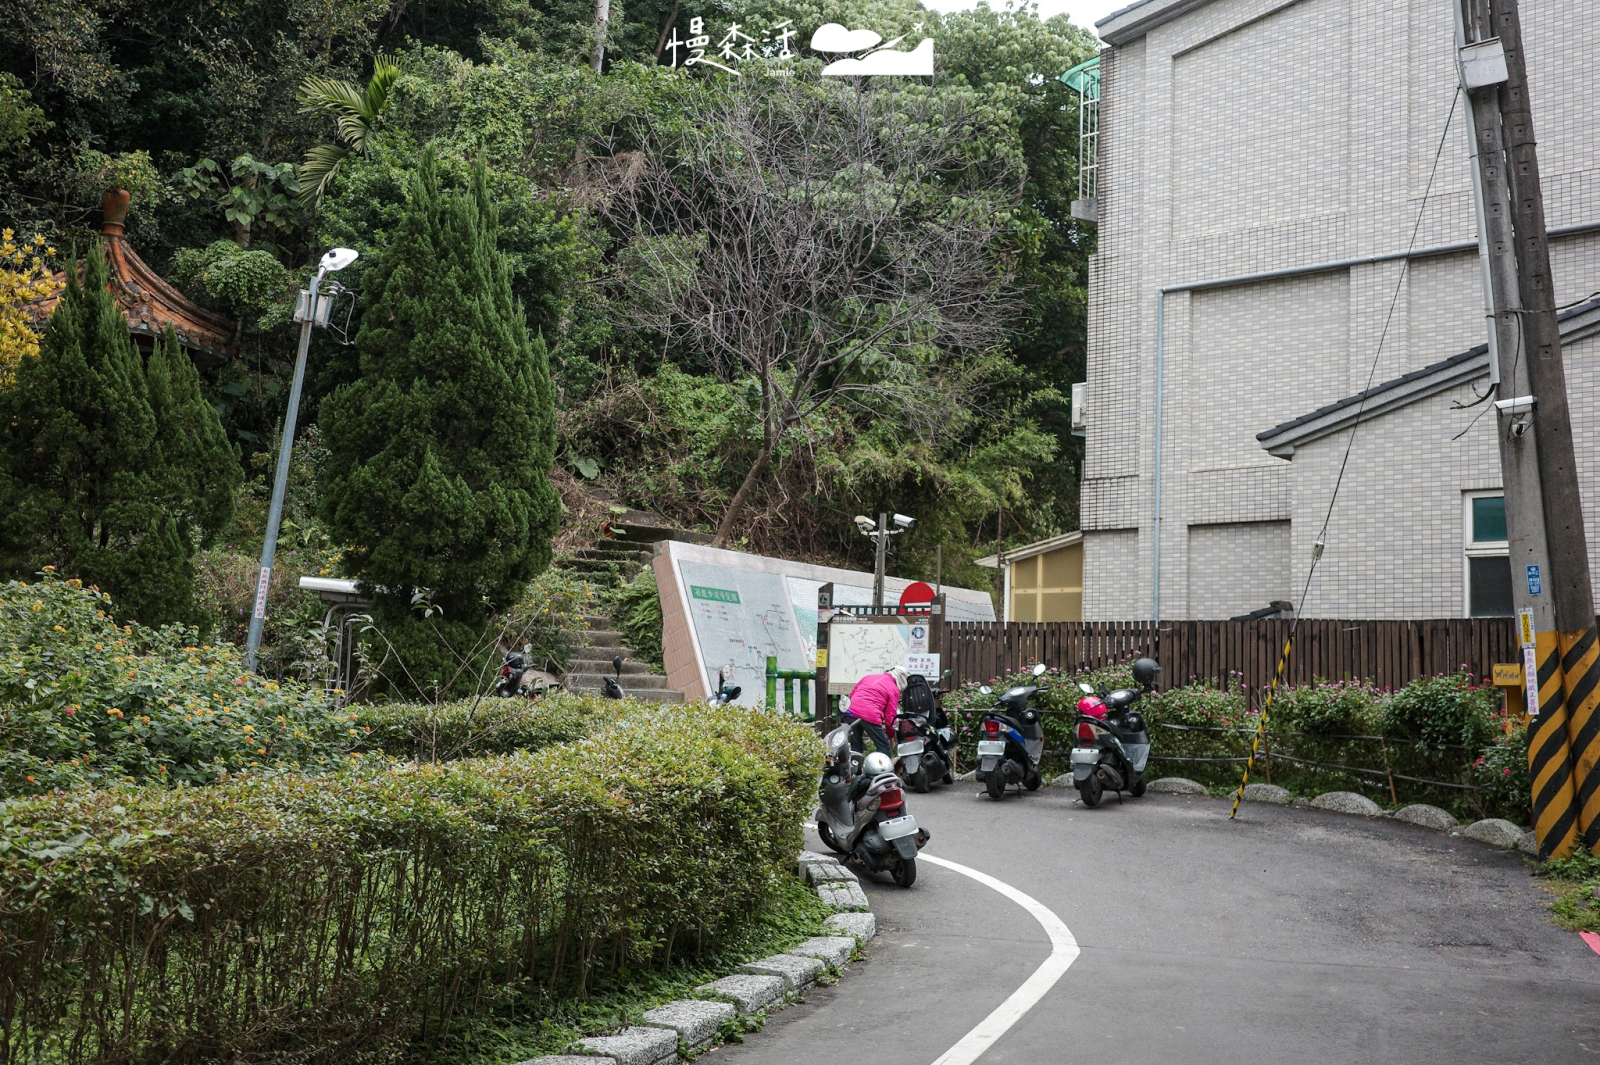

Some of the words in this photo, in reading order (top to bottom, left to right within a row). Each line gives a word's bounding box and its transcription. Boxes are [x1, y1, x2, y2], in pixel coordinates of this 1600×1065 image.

[1525, 649, 1537, 713] 南無大願地藏王菩薩
